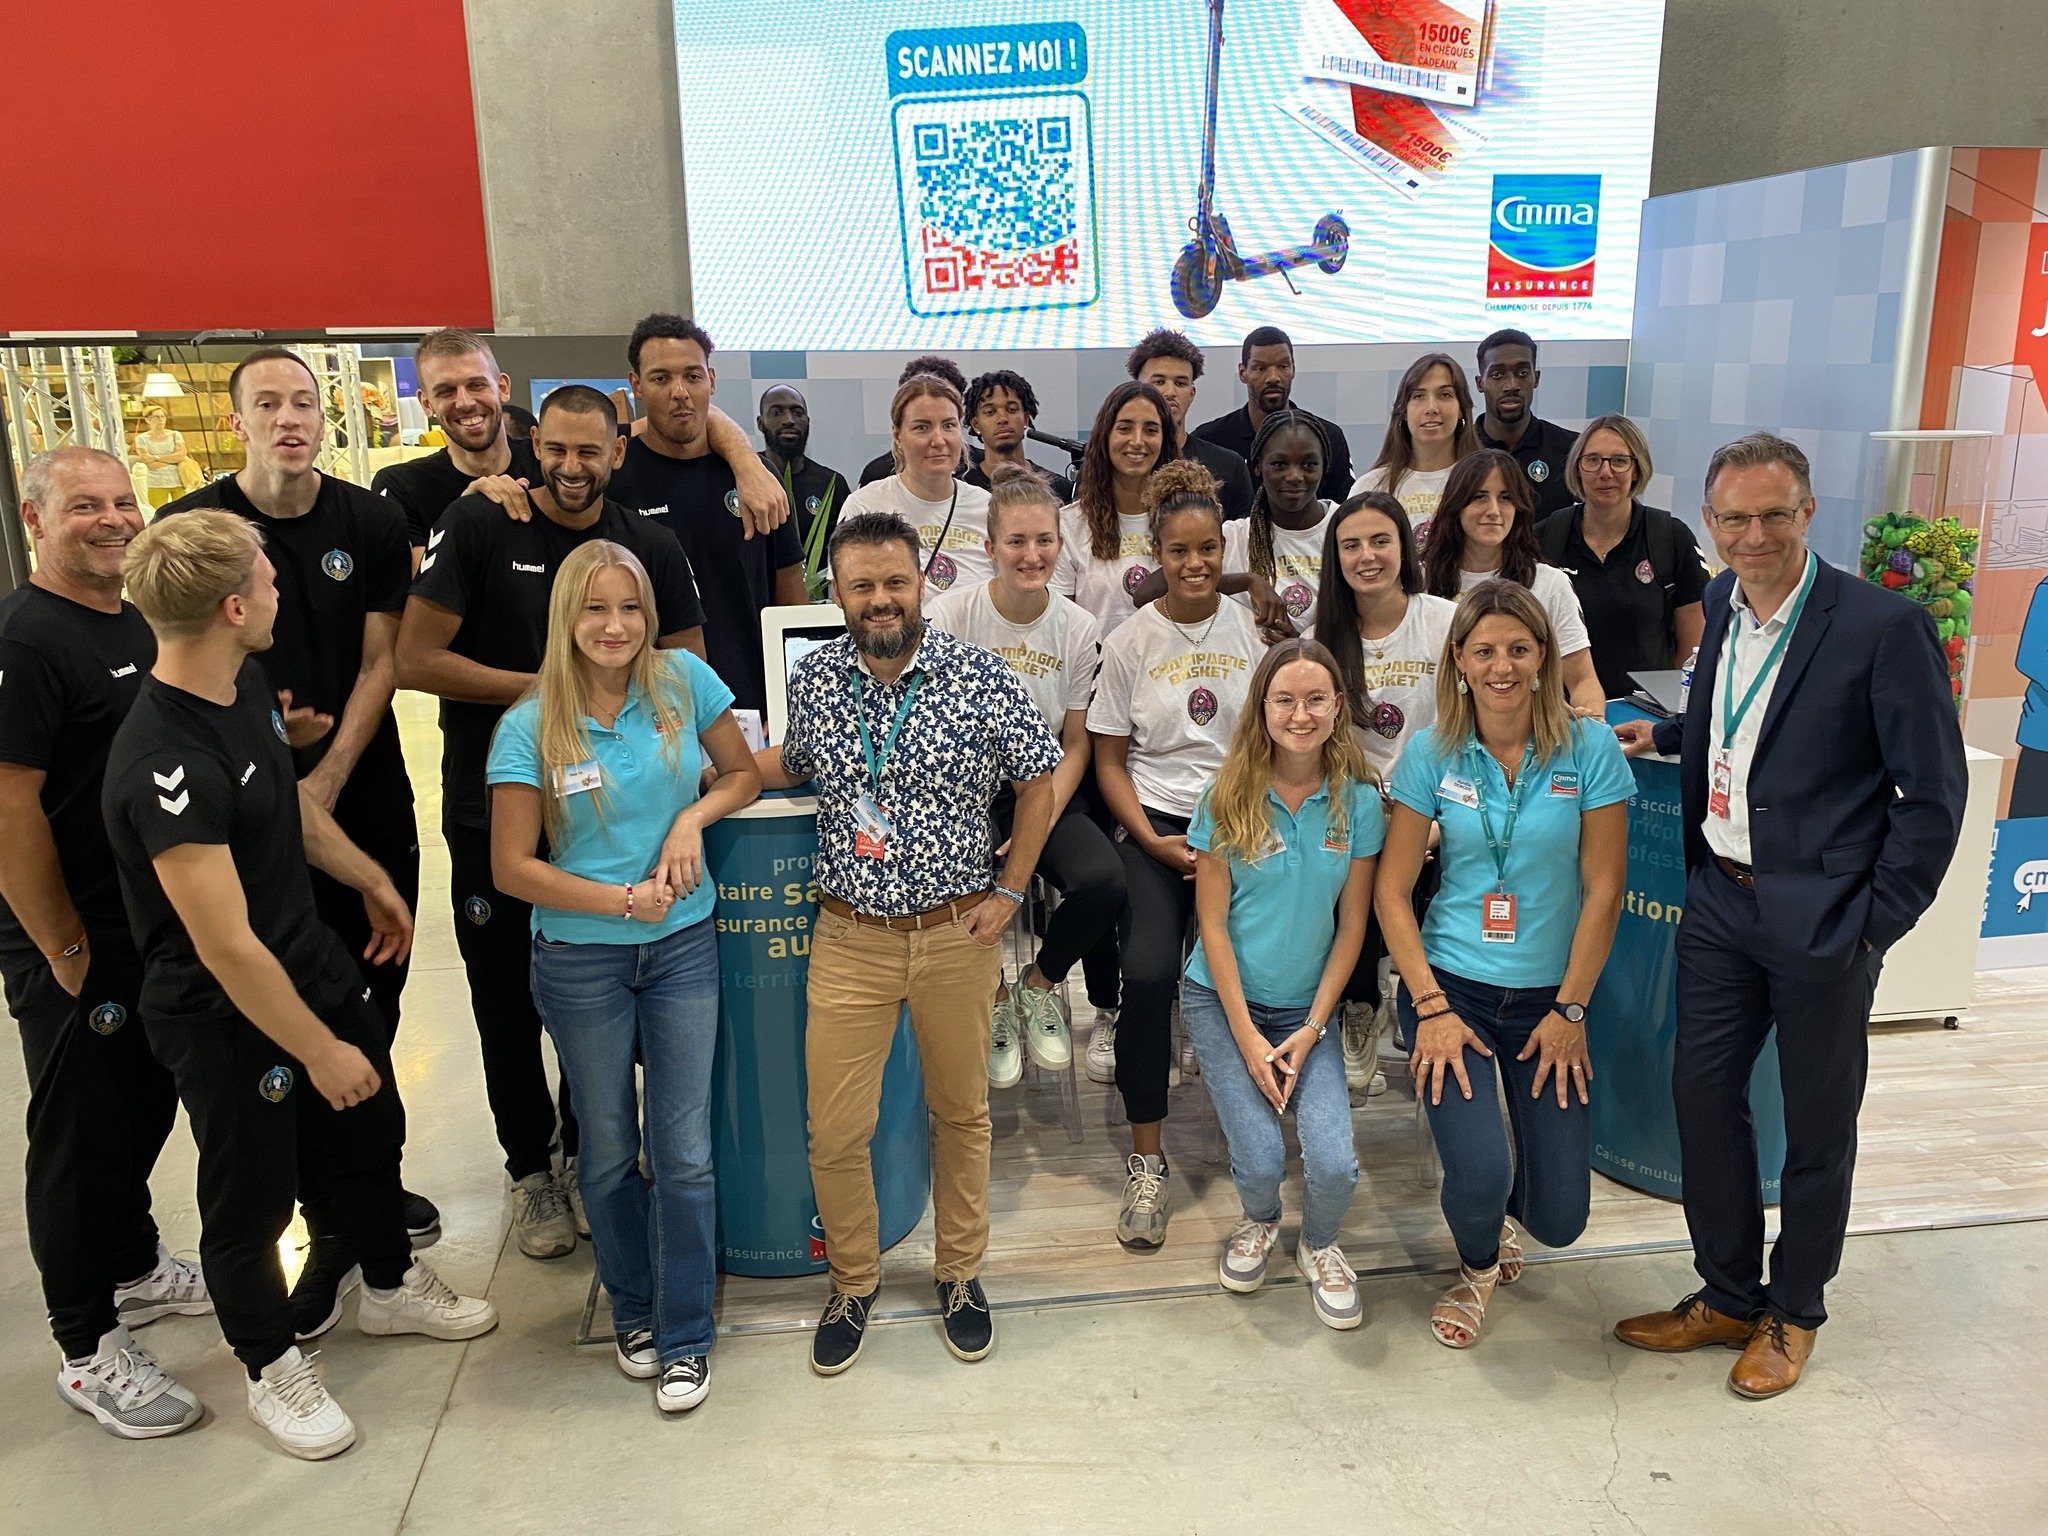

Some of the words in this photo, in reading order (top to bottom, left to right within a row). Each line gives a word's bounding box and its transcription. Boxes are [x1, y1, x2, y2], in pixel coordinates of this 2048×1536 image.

[1419, 22, 1472, 46] 1500€
[1419, 42, 1431, 53] EN
[898, 42, 1012, 78] SCANNEZ
[1018, 39, 1062, 73] MOI
[1069, 38, 1077, 70] !
[1418, 55, 1458, 71] CADEAUX
[1407, 132, 1453, 163] 1500€
[1492, 280, 1589, 291] ASSURANCE
[1573, 301, 1592, 310] 1774
[638, 504, 669, 517] hummel
[512, 560, 545, 573] hummel
[1148, 652, 1248, 681] CHAMPAGNE
[1168, 665, 1229, 687] BASKET
[718, 882, 773, 900] taire
[1621, 890, 1683, 925] tion
[716, 915, 808, 933] surance
[1595, 1144, 1636, 1171] Caisse
